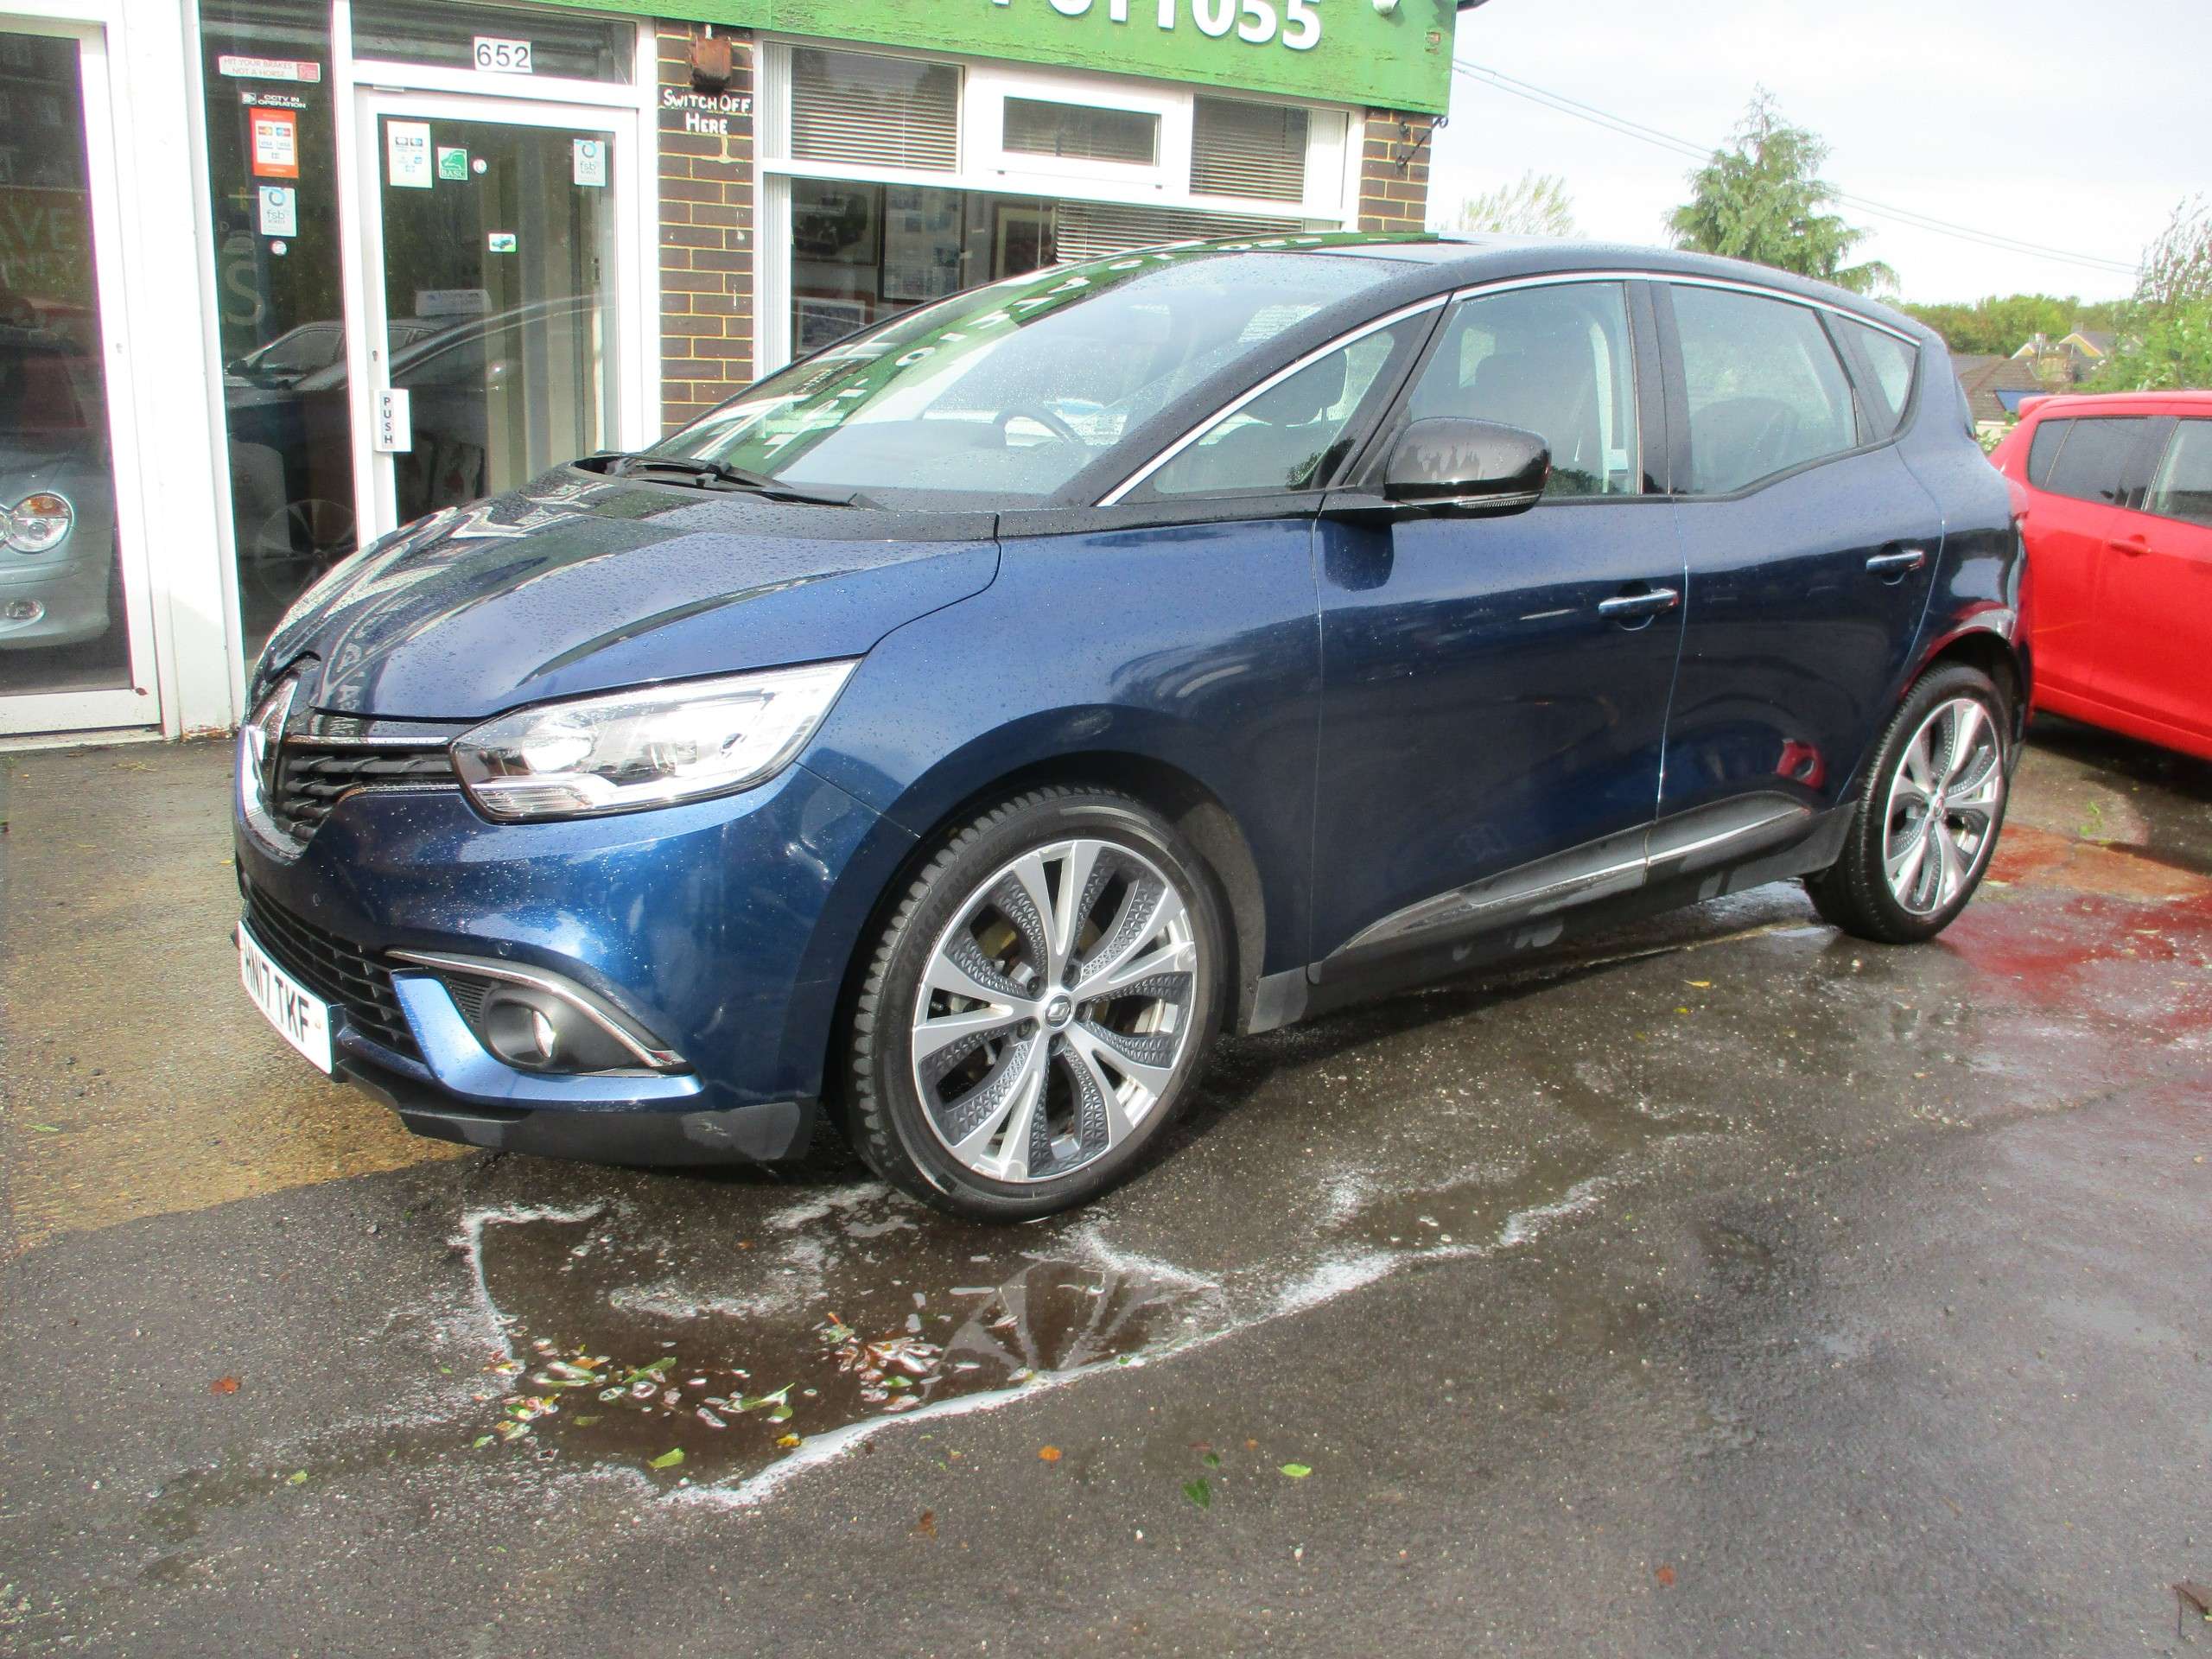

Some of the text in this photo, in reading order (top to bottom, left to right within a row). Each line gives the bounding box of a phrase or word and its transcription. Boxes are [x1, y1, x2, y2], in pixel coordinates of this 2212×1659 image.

[1048, 0, 1321, 50] 1055
[263, 60, 293, 69] BRAKES
[476, 43, 530, 67] 652
[257, 99, 307, 109] OPERATION
[720, 94, 751, 112] OFF
[685, 111, 728, 135] HERE
[267, 209, 285, 219] fsb
[383, 397, 393, 444] PUSH
[244, 937, 309, 1044] HN17 TKF
